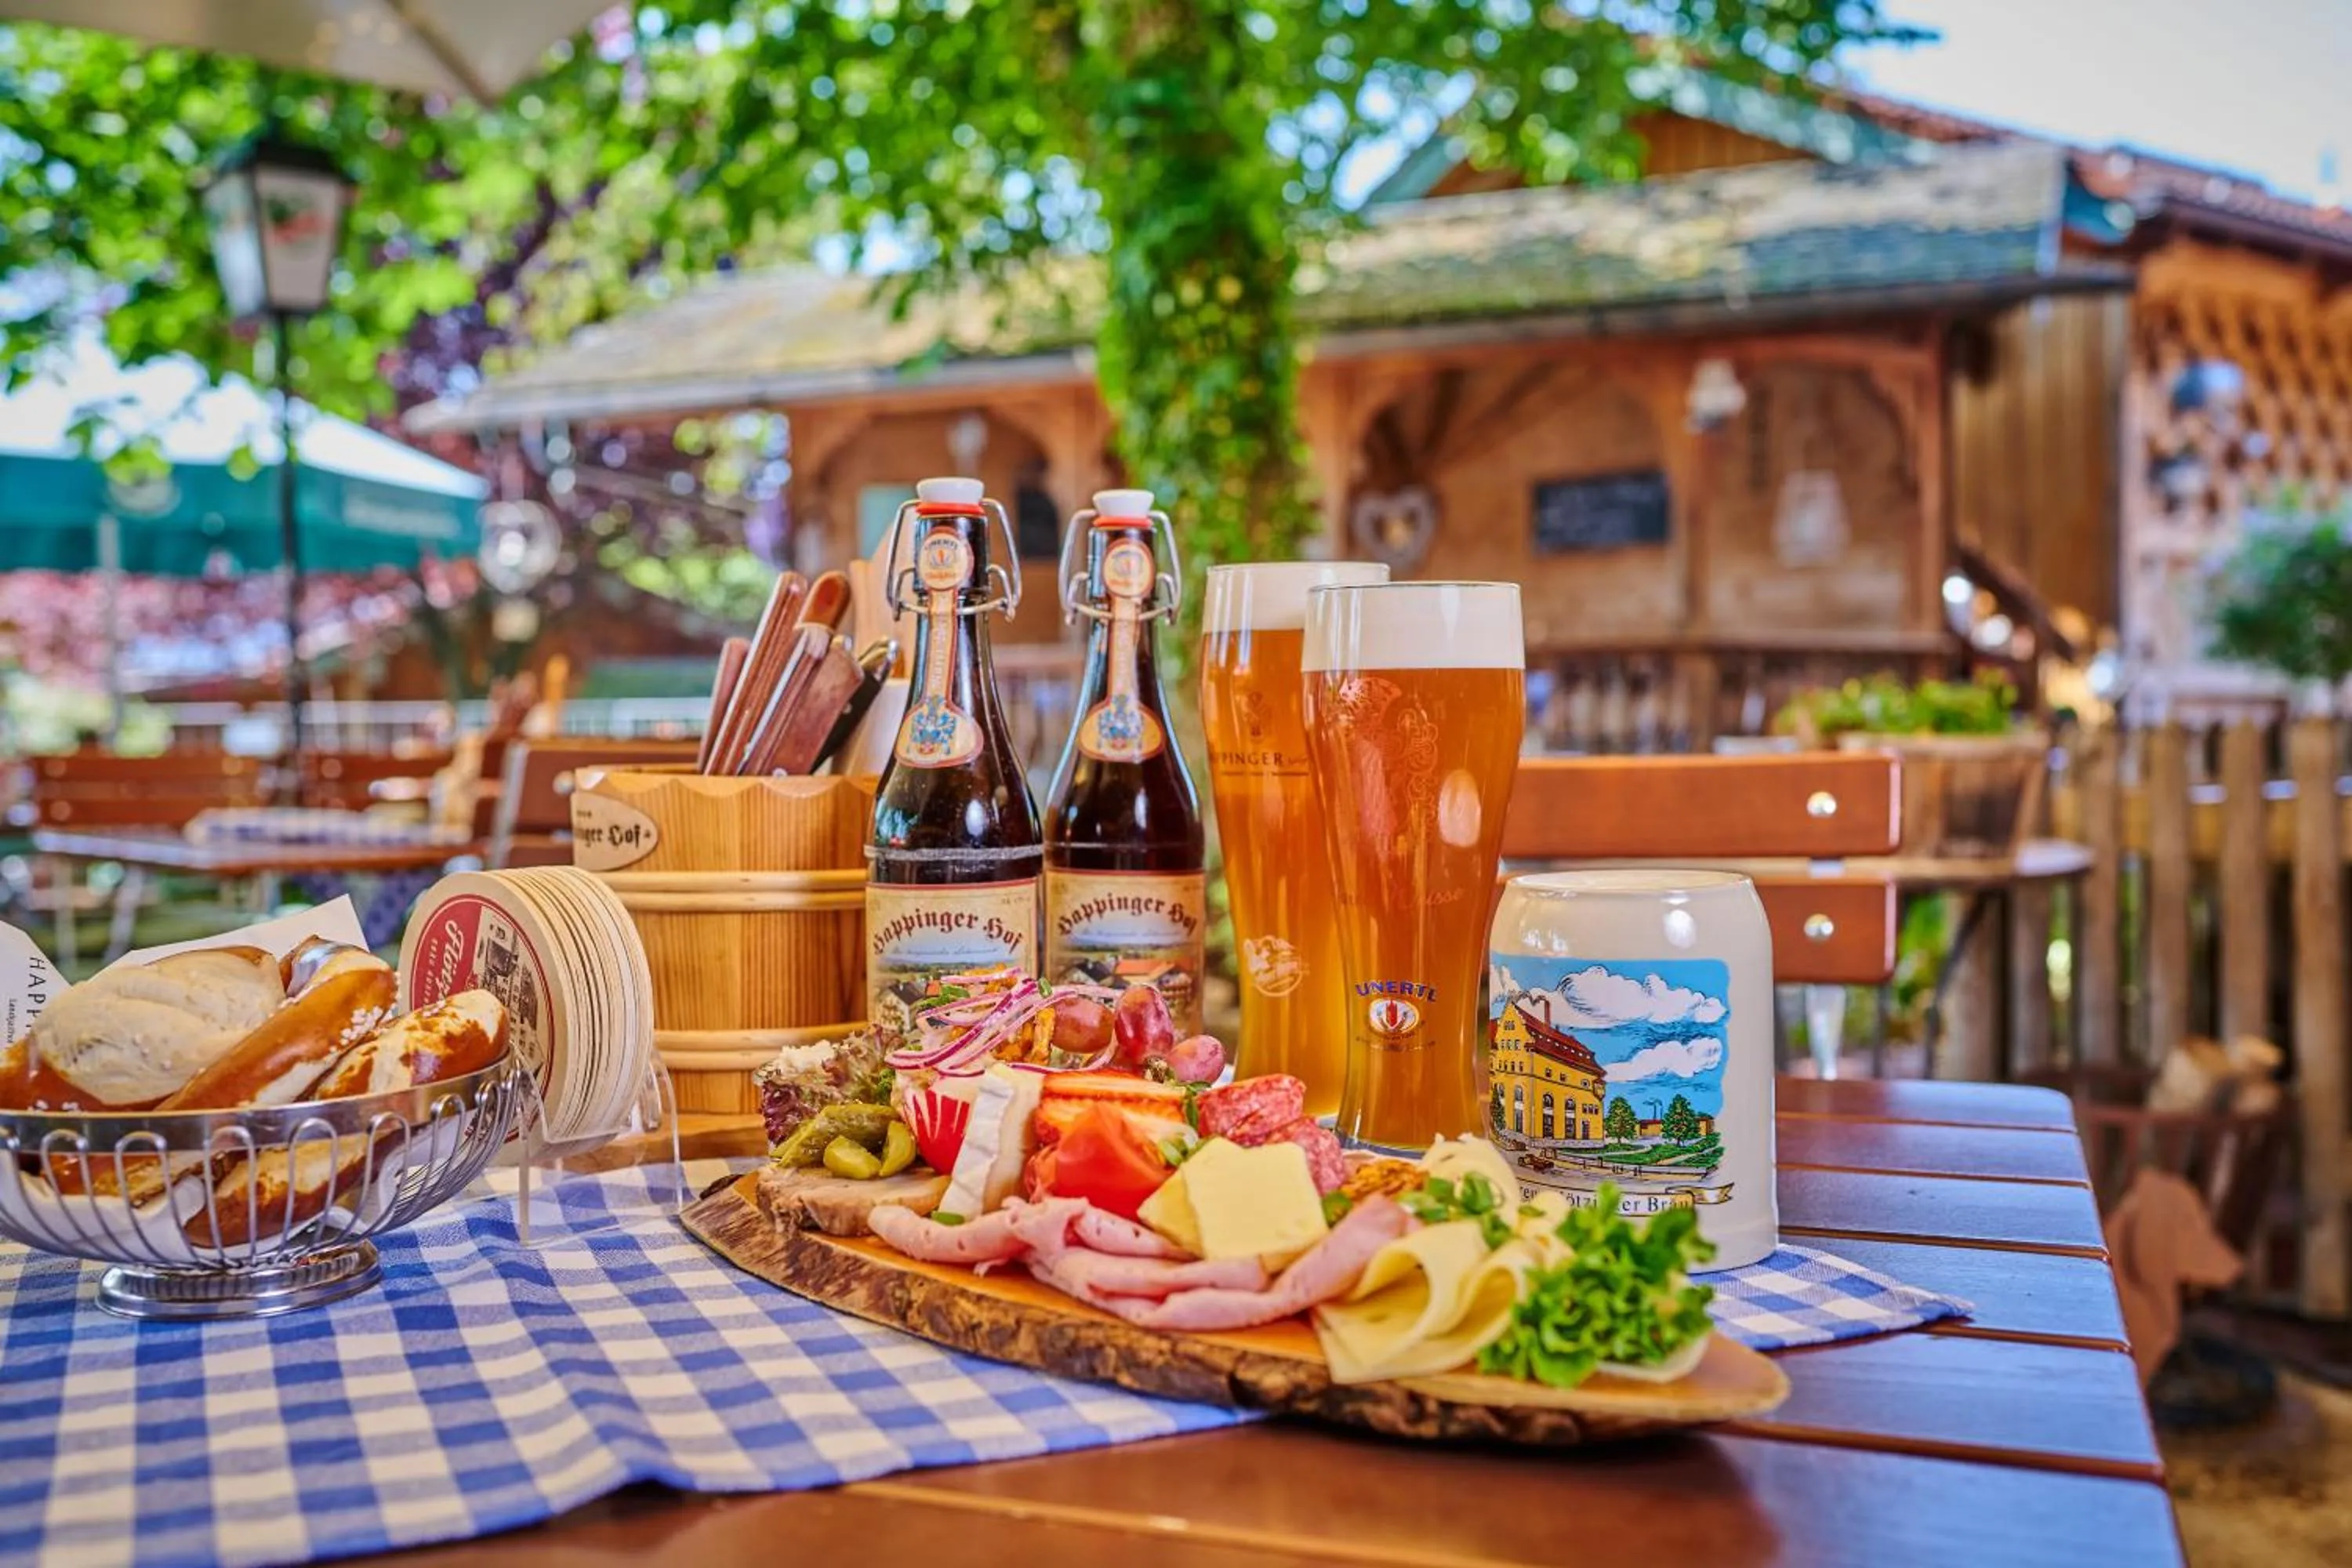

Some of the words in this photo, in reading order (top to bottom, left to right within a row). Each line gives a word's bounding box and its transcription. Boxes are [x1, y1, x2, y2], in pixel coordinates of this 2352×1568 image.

[873, 908, 979, 956] Happinger
[982, 916, 1024, 954] Hof
[1355, 980, 1436, 1003] UNERTL
